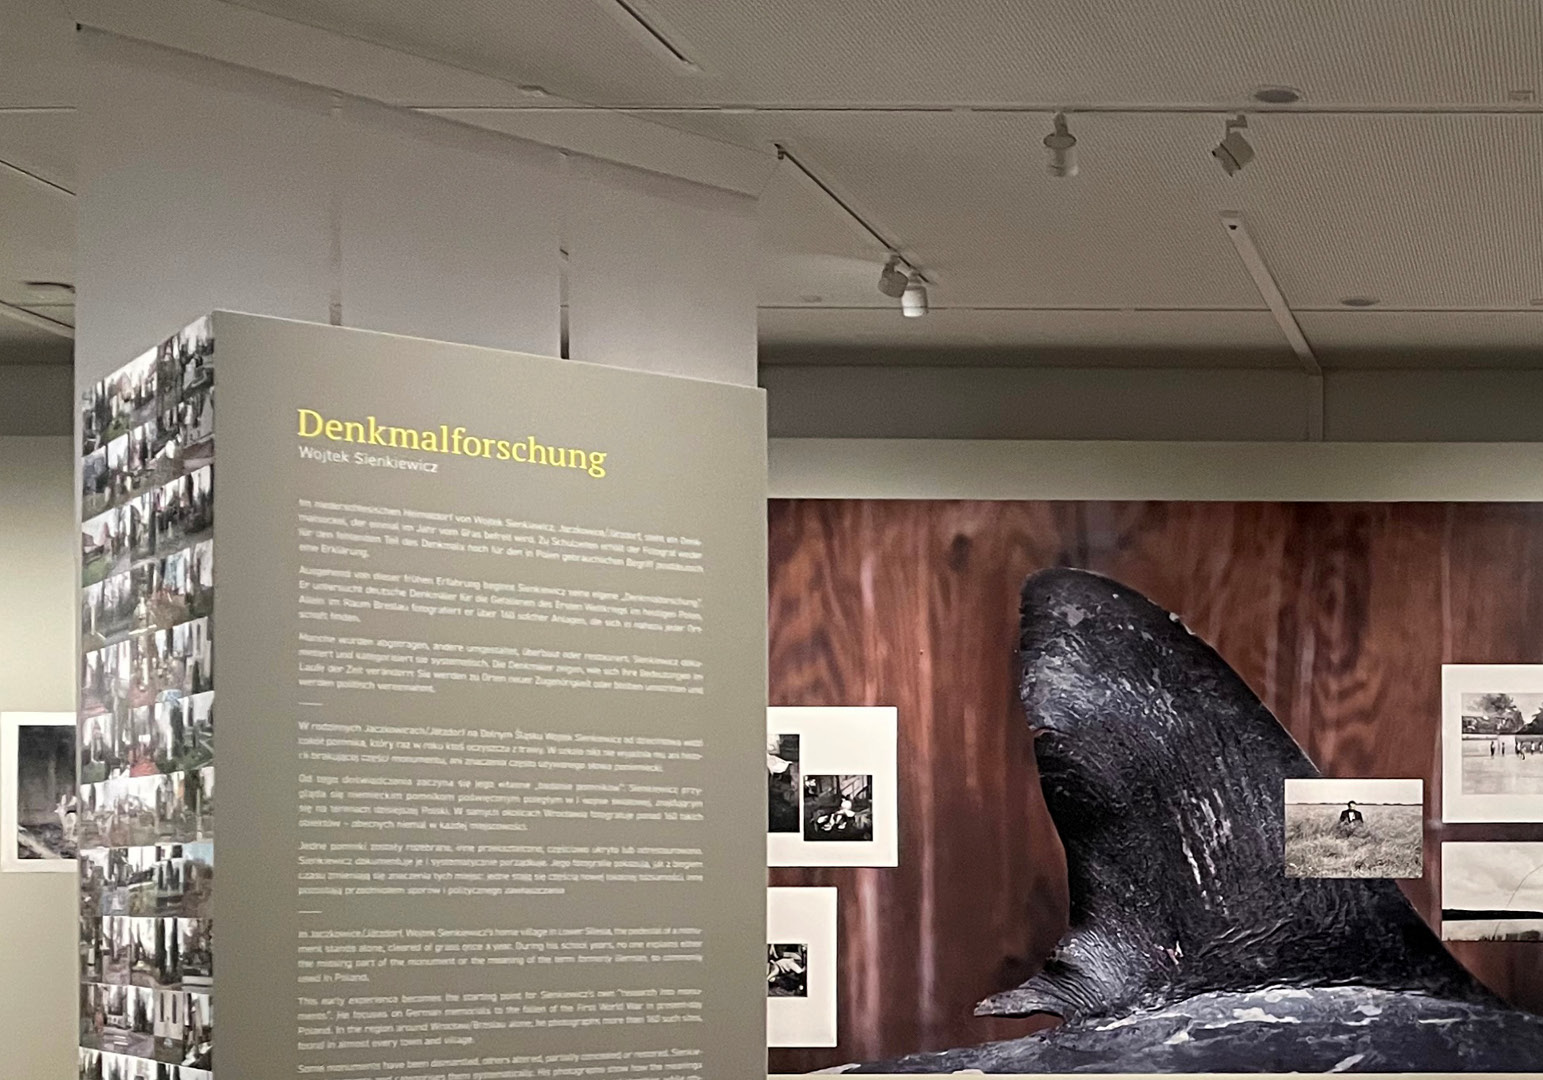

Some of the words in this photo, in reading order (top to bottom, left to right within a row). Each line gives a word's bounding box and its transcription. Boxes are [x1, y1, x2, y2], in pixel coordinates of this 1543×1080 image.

[297, 409, 607, 478] Denkmalforschung
[299, 446, 349, 464] Wojtek
[354, 452, 439, 473] Sienkiewicz
